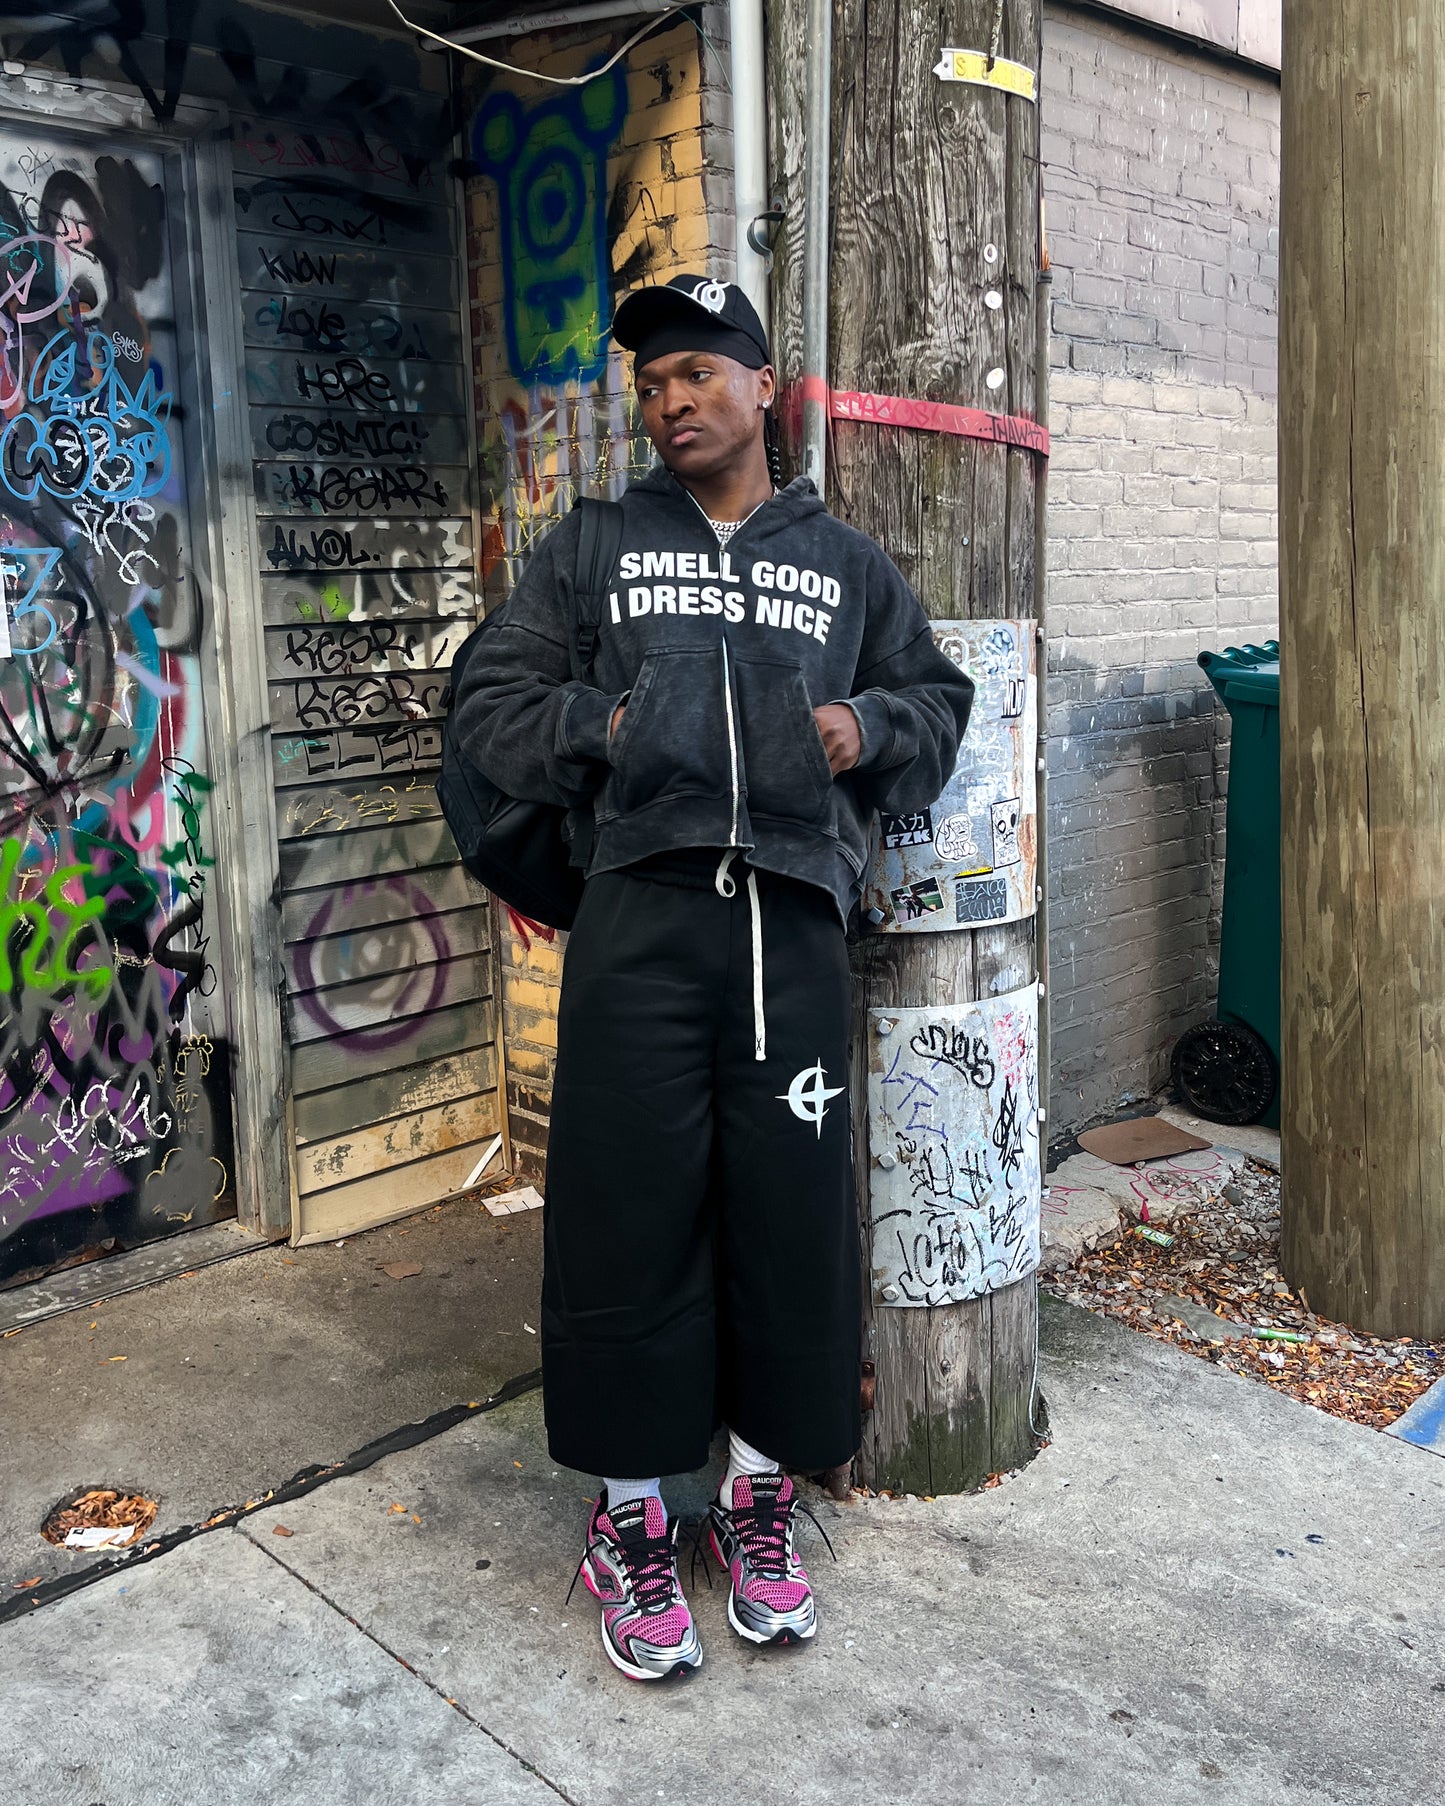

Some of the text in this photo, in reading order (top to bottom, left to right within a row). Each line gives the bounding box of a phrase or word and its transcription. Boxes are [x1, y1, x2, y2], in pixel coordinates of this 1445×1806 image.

[620, 551, 841, 608] SMELL GOOD
[609, 585, 832, 646] I DRESS NICE
[889, 813, 924, 832] バカ
[886, 829, 931, 848] FZK
[751, 1477, 782, 1486] SAUCONY
[610, 1501, 642, 1516] SAUCONY
